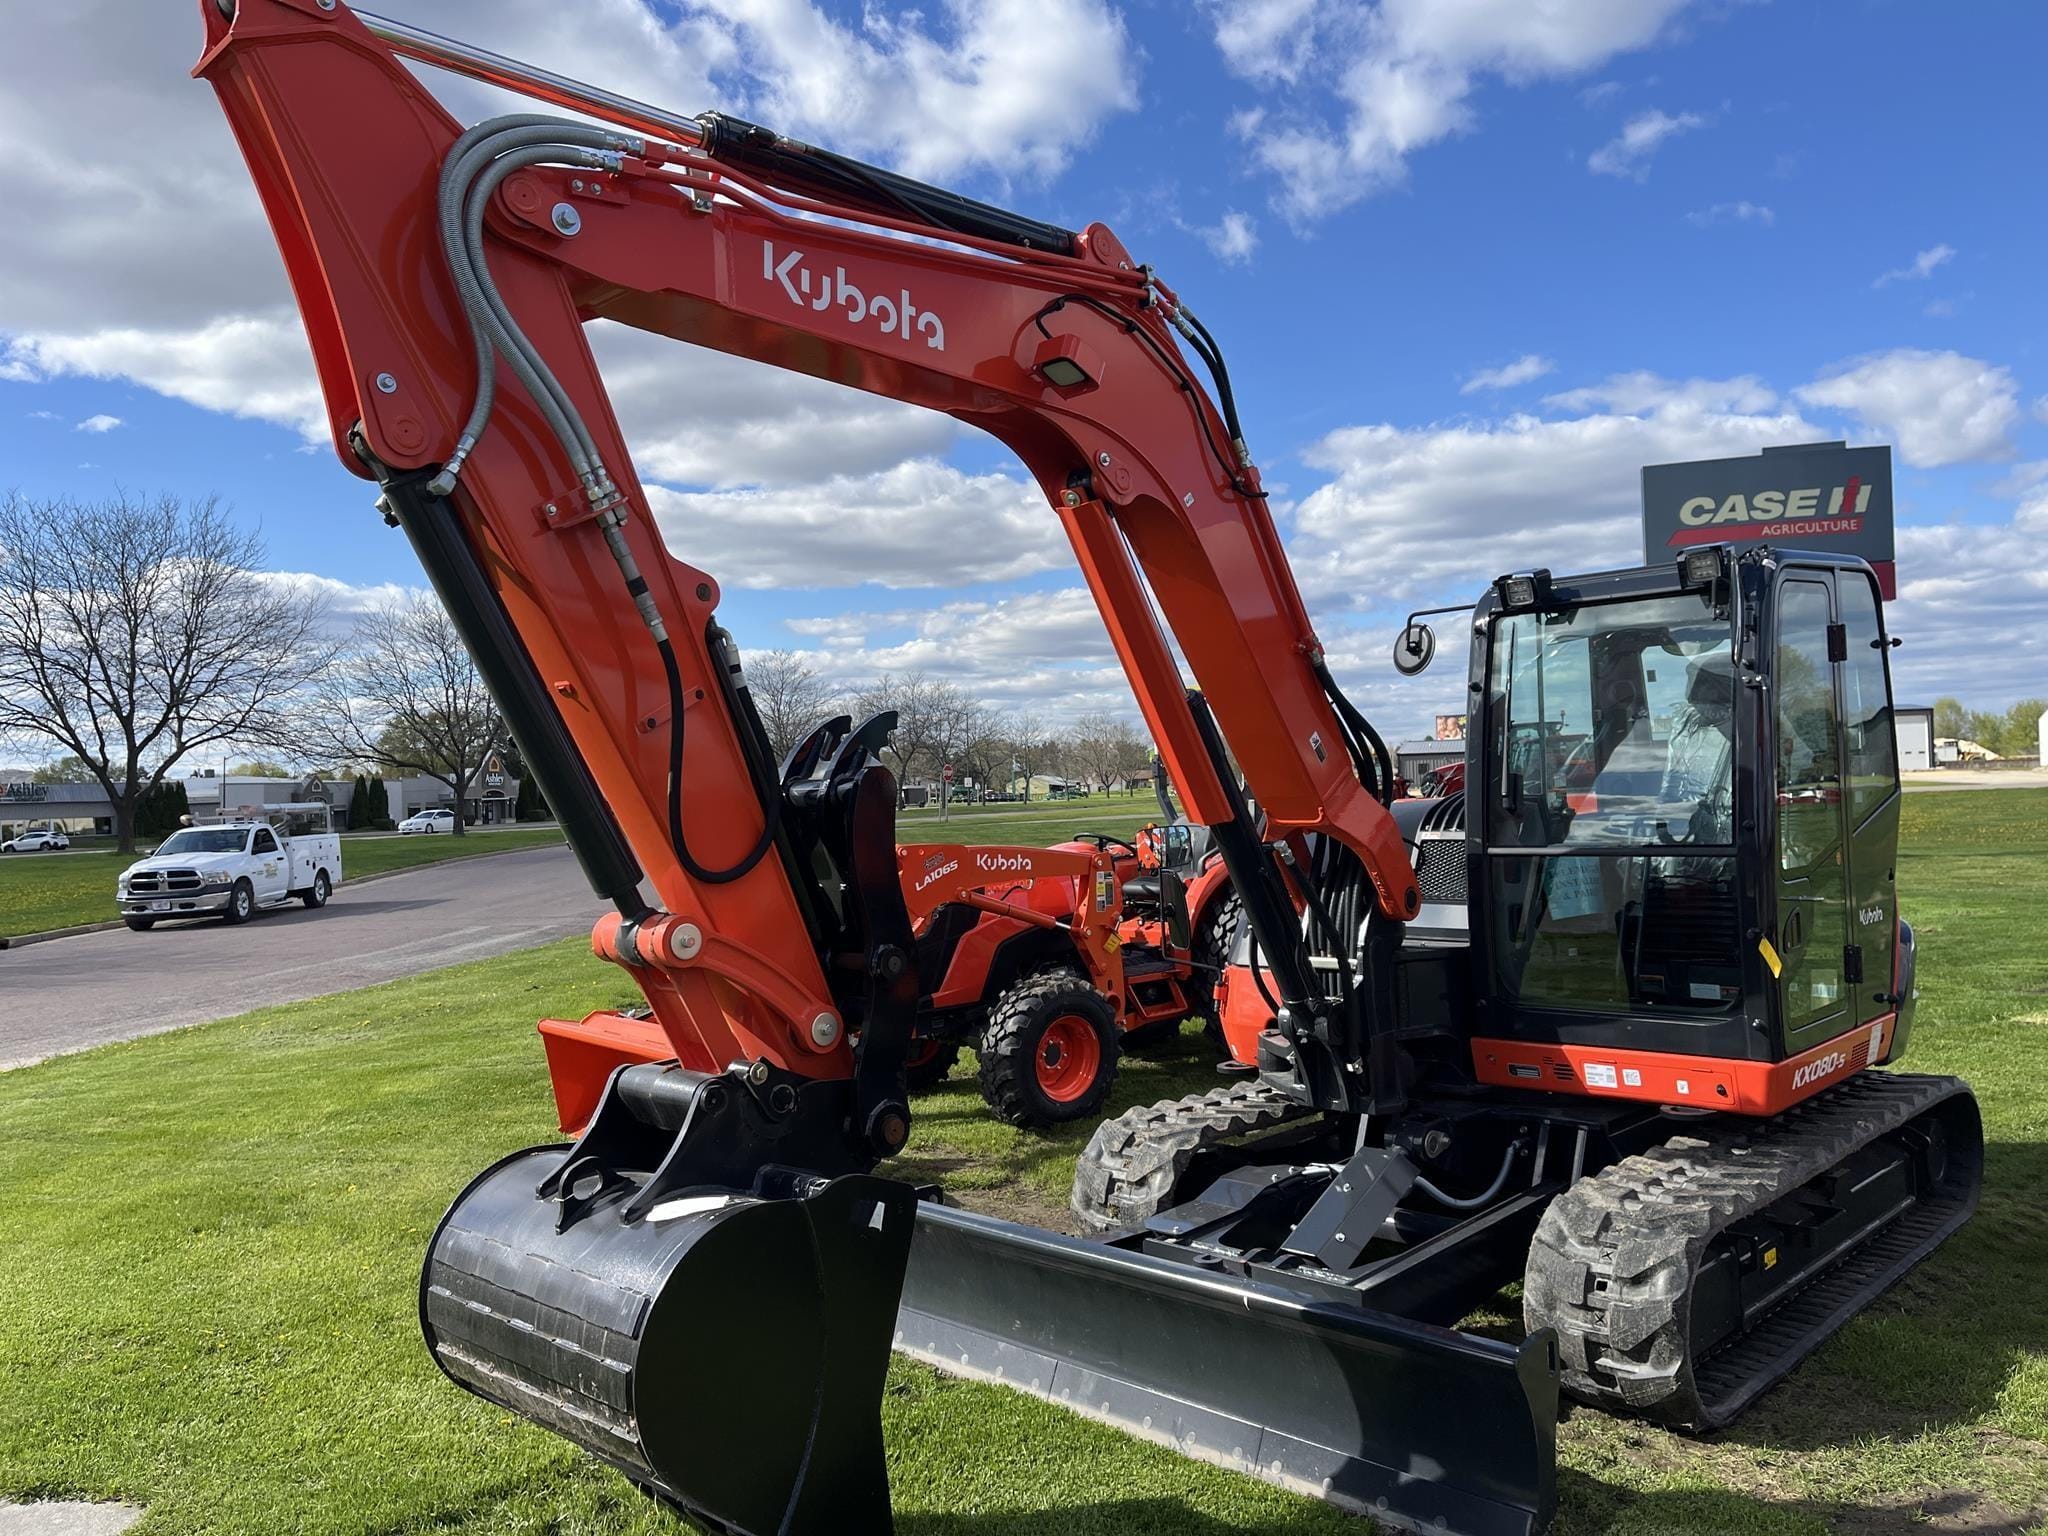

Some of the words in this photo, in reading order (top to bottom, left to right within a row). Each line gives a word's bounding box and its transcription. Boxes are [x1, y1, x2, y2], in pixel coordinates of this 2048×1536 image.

[764, 240, 944, 351] Kubota
[1679, 488, 1821, 526] CASE
[1761, 519, 1858, 536] AGRICULTURE
[6, 781, 49, 798] Ashley
[976, 853, 1032, 871] Kubota
[914, 860, 959, 891] LA1065
[1859, 905, 1884, 926] Kubota
